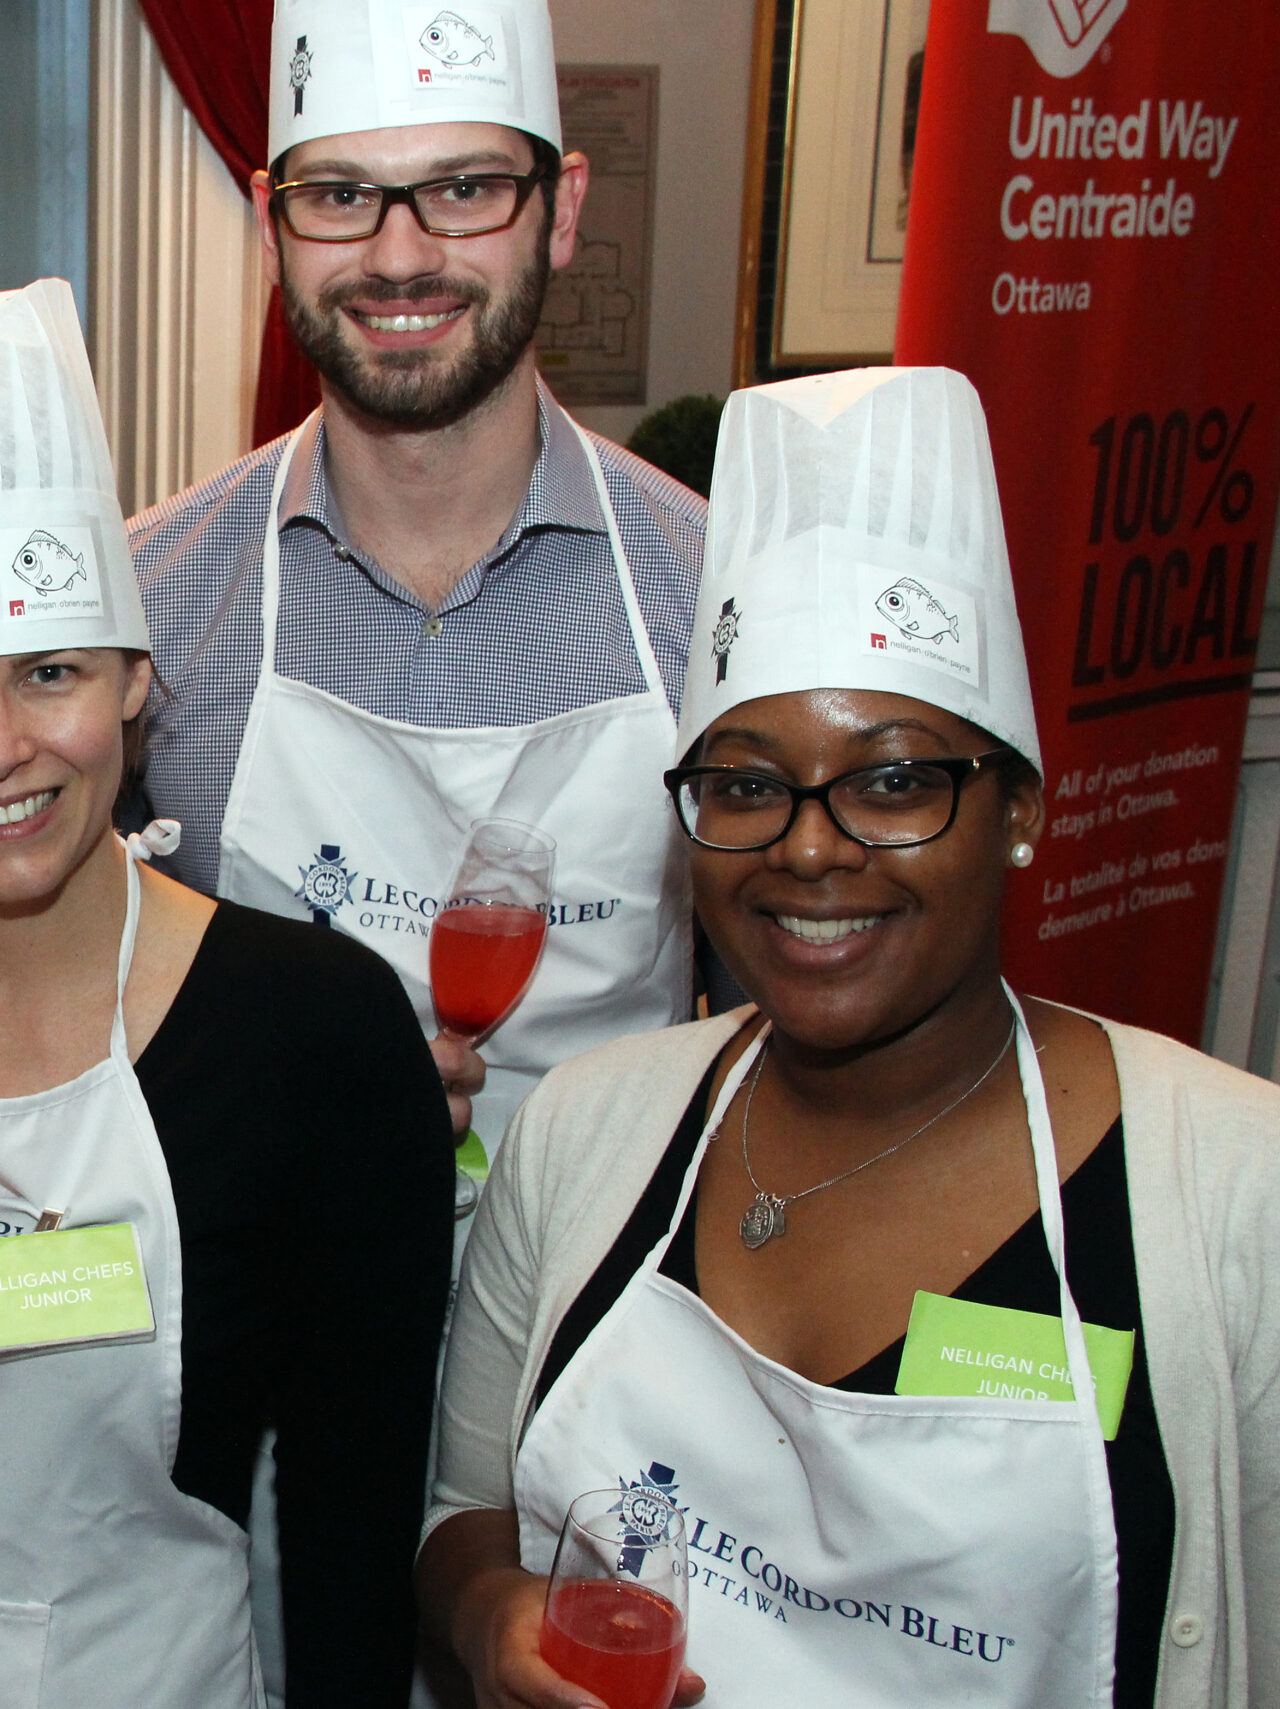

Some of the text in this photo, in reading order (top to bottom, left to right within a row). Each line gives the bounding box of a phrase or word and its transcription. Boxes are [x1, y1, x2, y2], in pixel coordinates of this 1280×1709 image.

[1009, 96, 1239, 178] United Way
[1000, 175, 1195, 240] Centraide
[992, 272, 1091, 315] Ottawa
[1088, 402, 1257, 545] 100%
[28, 601, 57, 611] nelligan
[1072, 539, 1258, 687] LOCAL
[890, 640, 922, 653] nelligan
[1054, 743, 1220, 800] All of your donation
[1051, 811, 1095, 840] stays
[1097, 803, 1113, 824] in
[1042, 878, 1065, 904] La
[1069, 858, 1125, 898] totalité
[1129, 852, 1147, 879] de
[1152, 849, 1181, 870] vos
[359, 911, 430, 939] OTTAW
[1037, 902, 1113, 941] demeure
[72, 1261, 135, 1285] CHEFS
[19, 1287, 92, 1311] JUNIOR
[940, 1346, 1033, 1375] NELLIGAN
[687, 1516, 738, 1564] LE
[740, 1545, 893, 1628] CORDON
